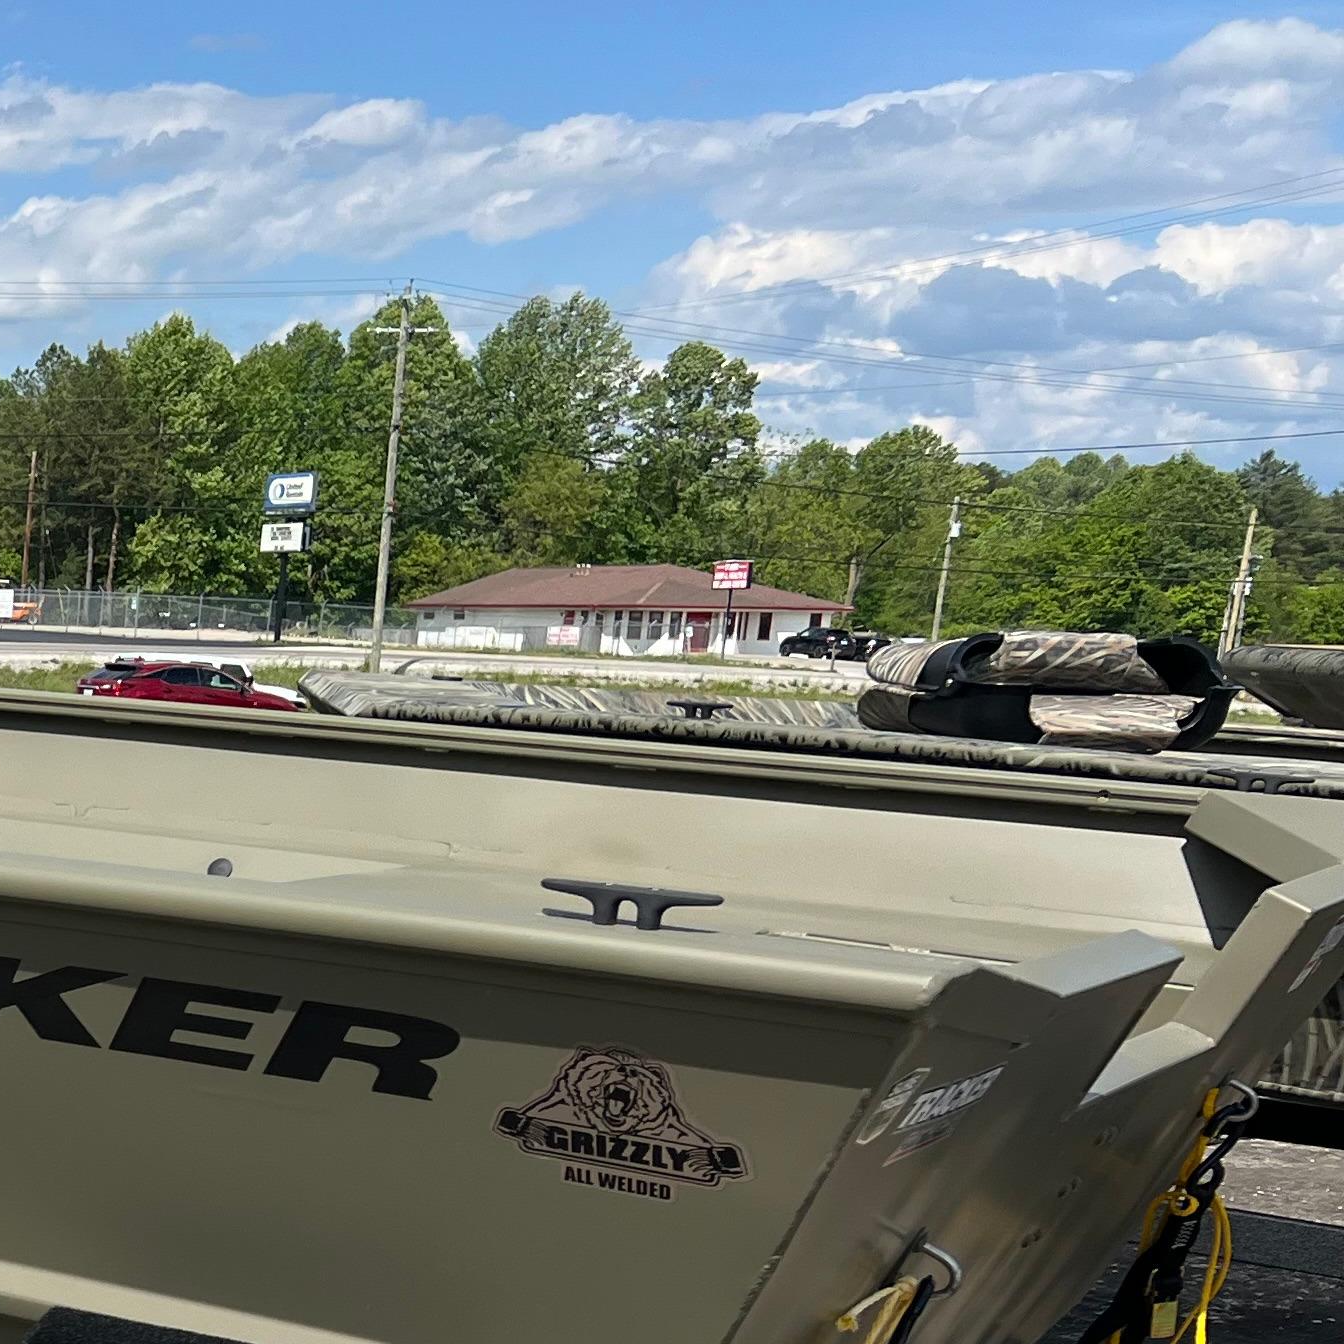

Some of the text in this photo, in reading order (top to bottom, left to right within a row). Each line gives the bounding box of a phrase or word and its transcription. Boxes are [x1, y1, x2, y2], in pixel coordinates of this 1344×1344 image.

[544, 1125, 690, 1172] GRIZZLY
[564, 1166, 671, 1200] ALL WELDED
